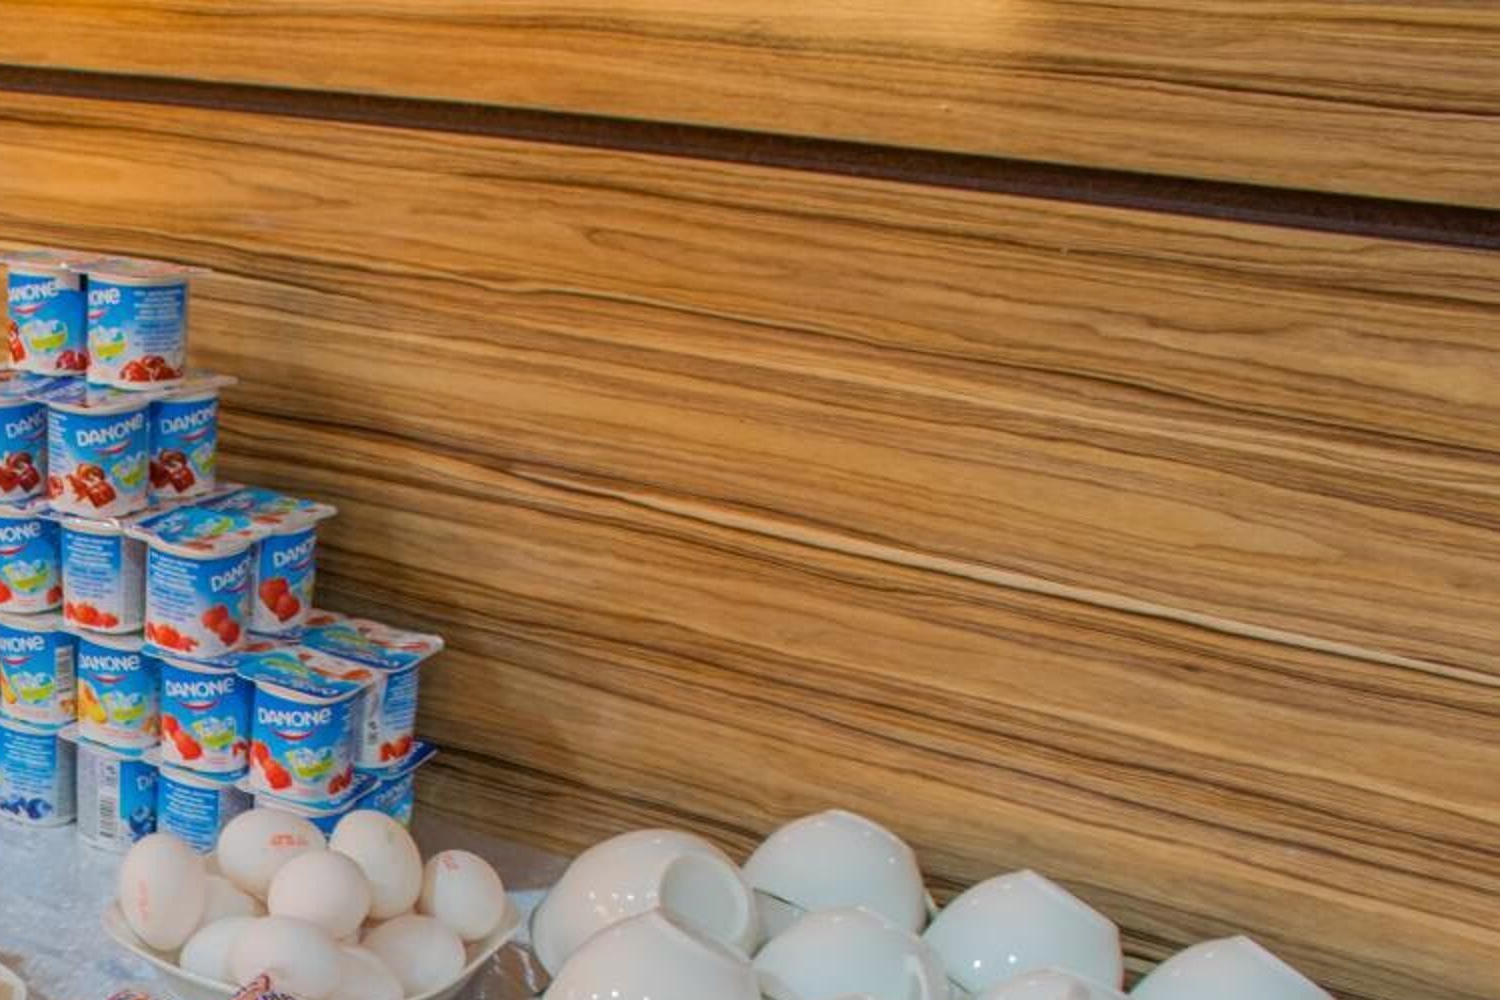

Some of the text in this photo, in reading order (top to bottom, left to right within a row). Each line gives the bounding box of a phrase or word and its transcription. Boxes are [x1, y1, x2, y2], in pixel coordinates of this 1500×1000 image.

[75, 413, 144, 447] DANONE
[160, 406, 217, 434] DANON
[164, 677, 235, 698] DANONE
[257, 707, 332, 728] DANONE
